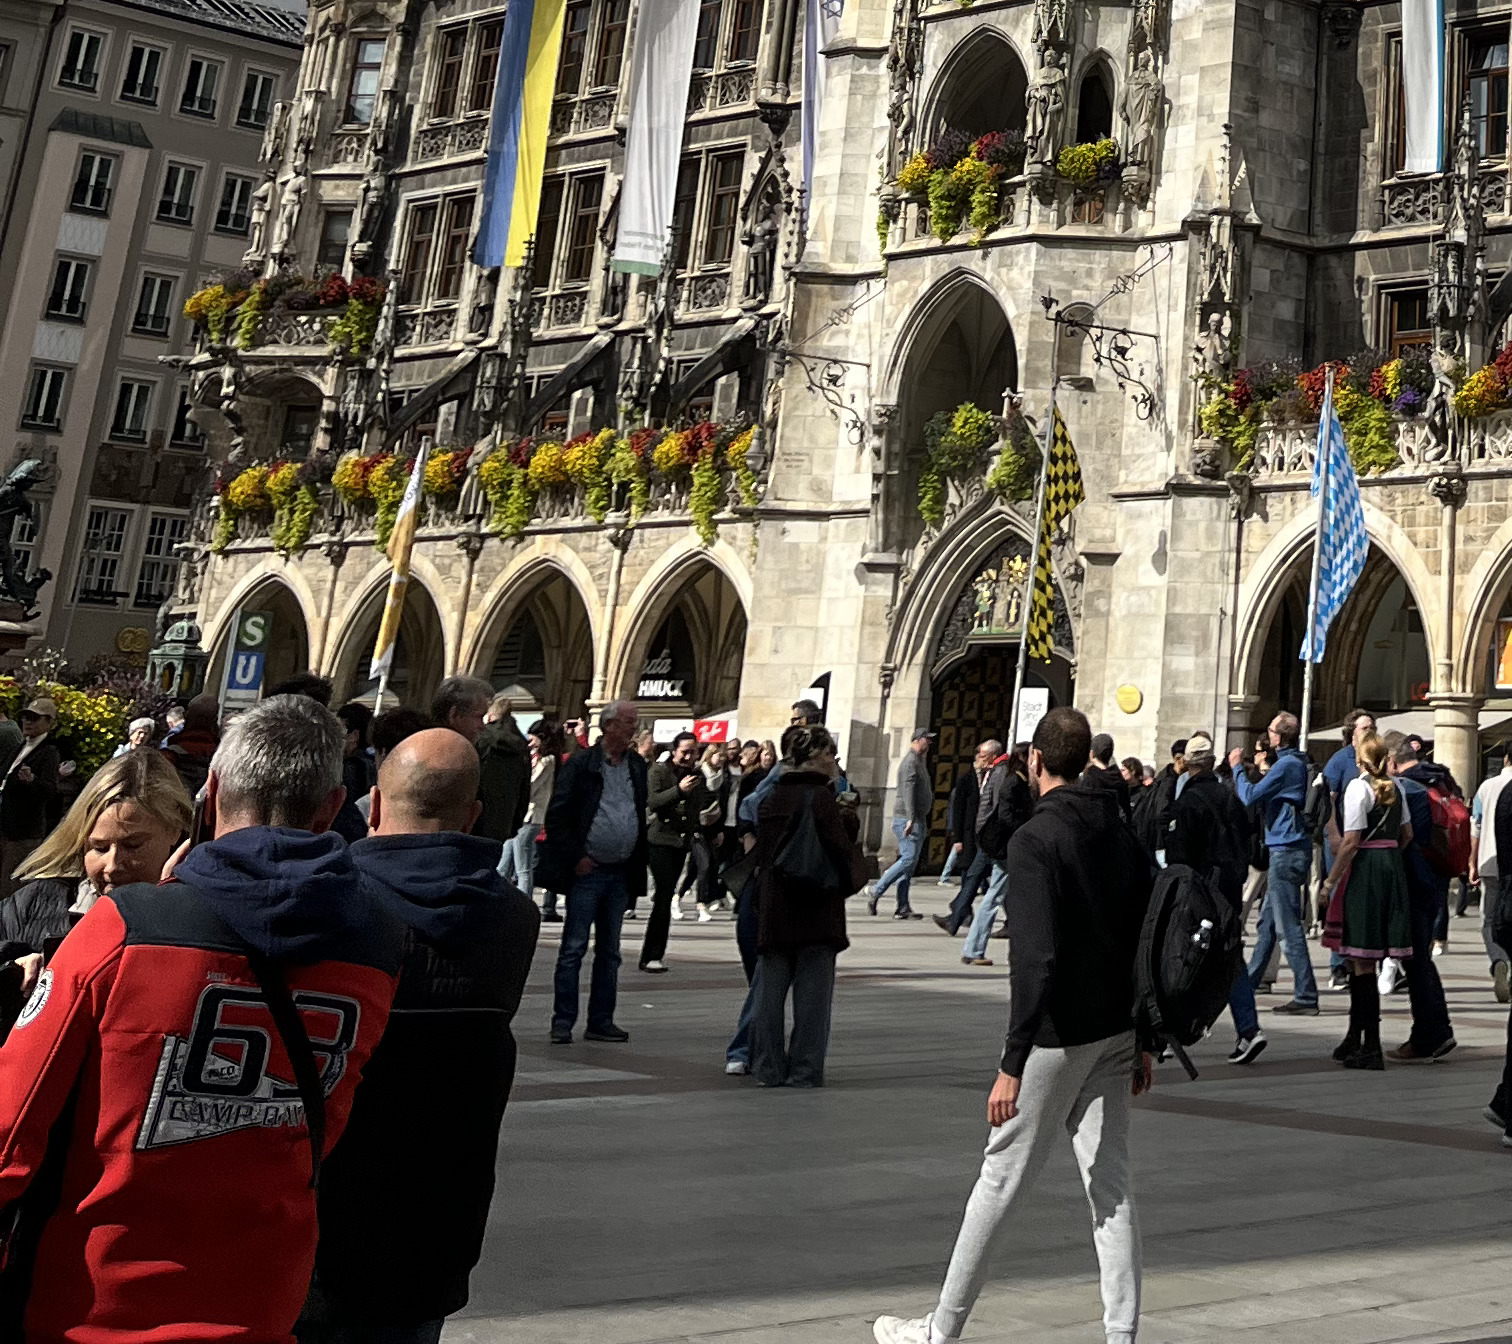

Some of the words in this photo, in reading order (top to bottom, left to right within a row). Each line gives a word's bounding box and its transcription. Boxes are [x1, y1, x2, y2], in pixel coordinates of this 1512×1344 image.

[241, 616, 265, 646] S
[235, 654, 258, 685] U
[638, 680, 684, 697] HMUCK
